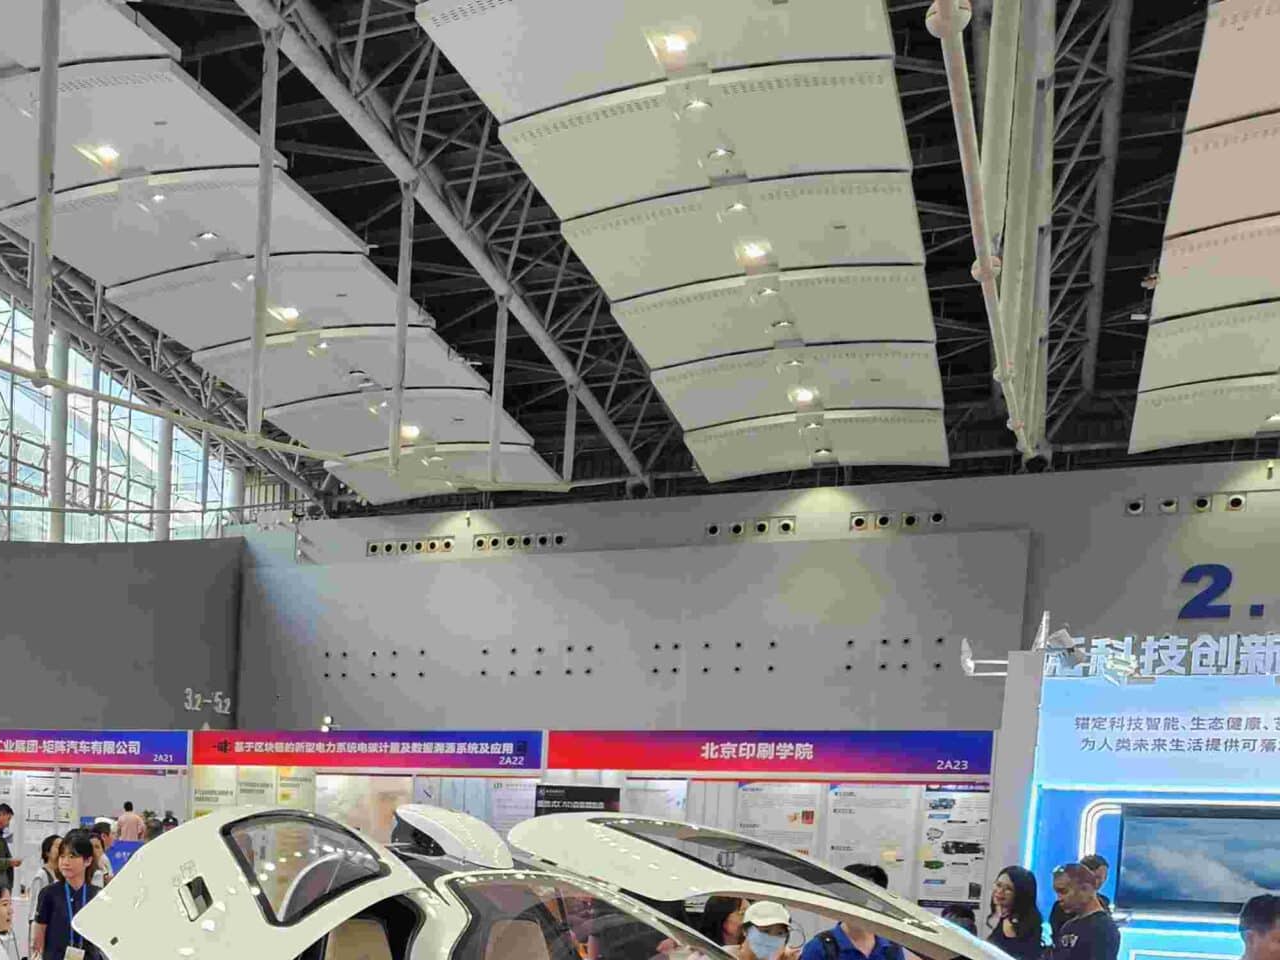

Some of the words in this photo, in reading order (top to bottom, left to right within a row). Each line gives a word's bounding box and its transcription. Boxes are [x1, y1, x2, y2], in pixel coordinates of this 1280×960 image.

[700, 742, 814, 760] 北京印刷学院
[1080, 738, 1280, 753] 为人类未来生活提供可落
[152, 754, 173, 762] 2A21
[498, 756, 525, 765] 2A22
[936, 759, 969, 770] 2A23
